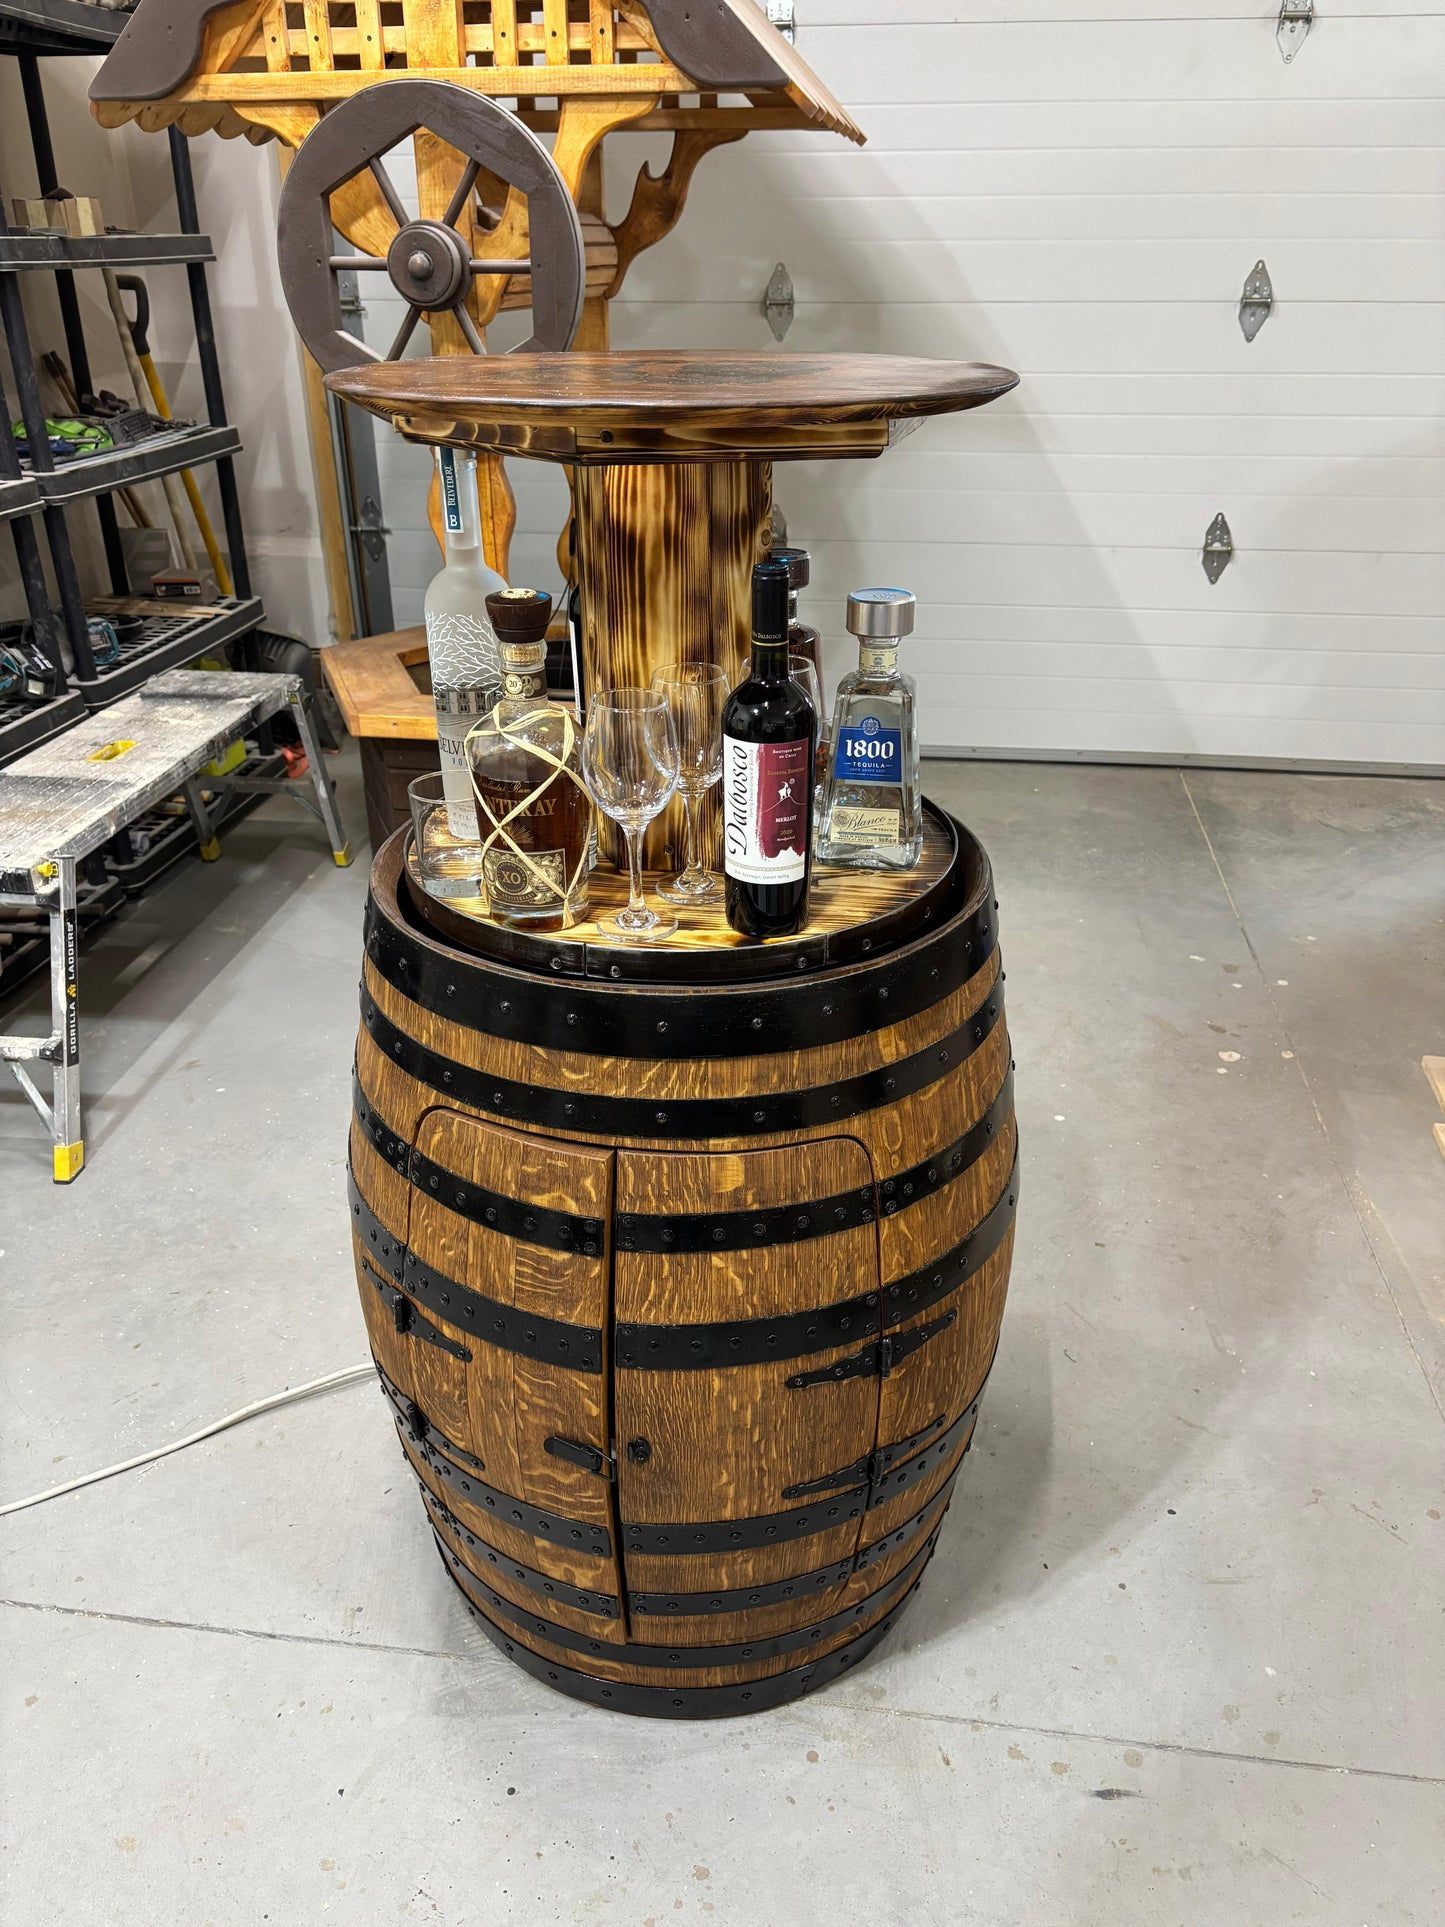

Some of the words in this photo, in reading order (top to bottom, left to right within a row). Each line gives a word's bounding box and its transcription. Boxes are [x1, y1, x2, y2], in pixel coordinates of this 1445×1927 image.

[444, 465, 456, 506] BELVEDERE
[450, 514, 458, 527] B
[757, 632, 782, 640] DALBOSCO
[845, 739, 894, 759] 1800
[852, 761, 885, 769] TEQUILA
[725, 745, 748, 856] Dalbosco
[775, 814, 798, 823] MERLOT
[846, 811, 886, 831] Blanco
[501, 870, 521, 885] XO
[67, 923, 76, 980] LADDERS
[68, 1001, 77, 1054] GORILLA
